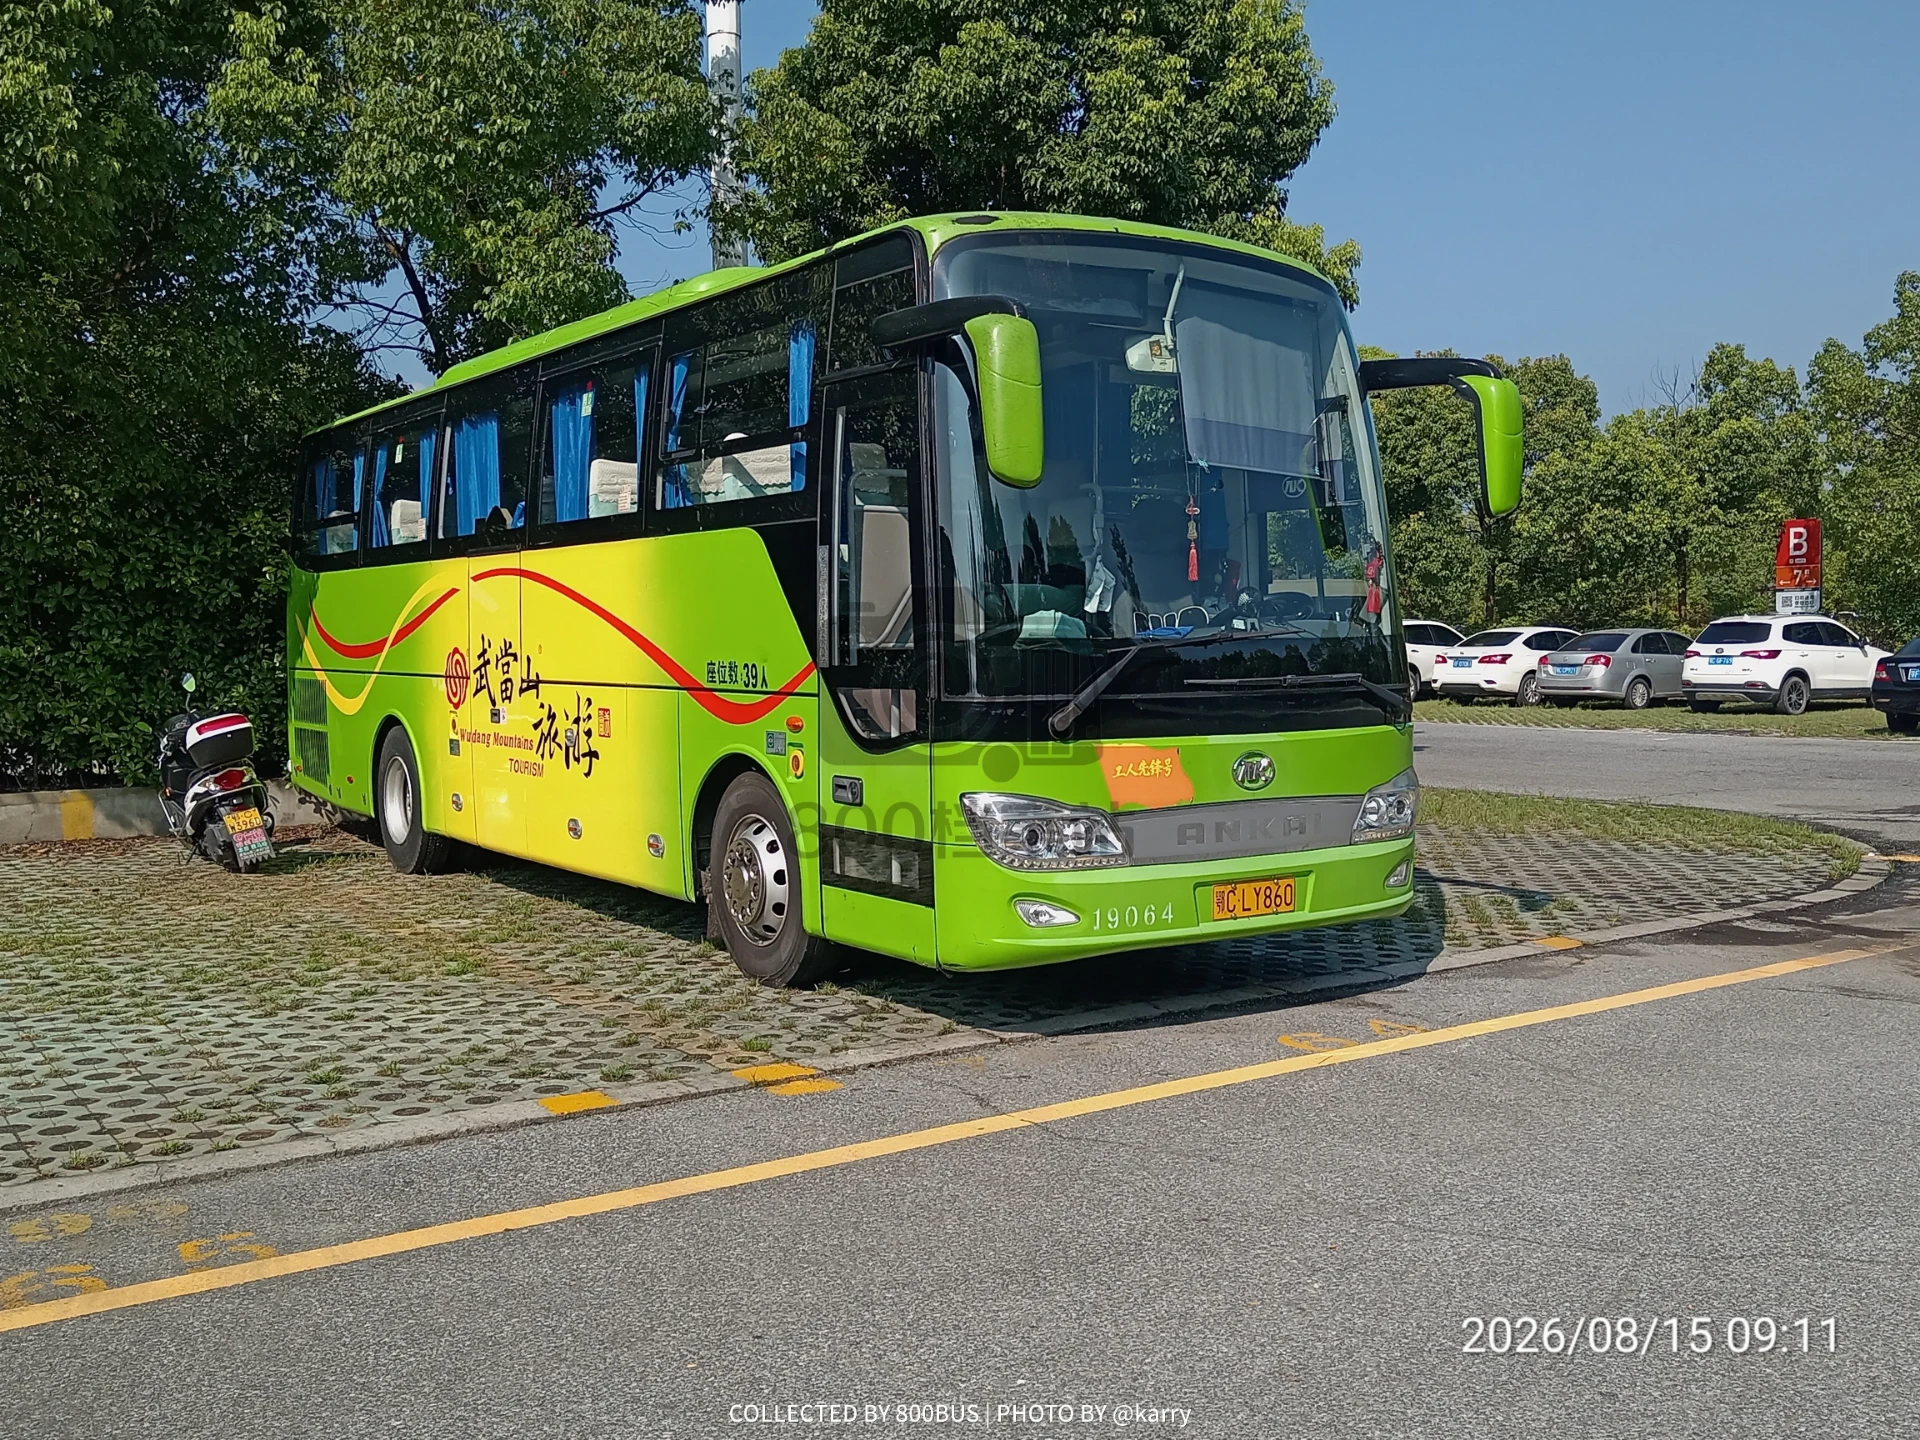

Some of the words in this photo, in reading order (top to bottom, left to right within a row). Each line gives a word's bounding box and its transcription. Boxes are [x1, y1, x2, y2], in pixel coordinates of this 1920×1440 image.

[1789, 527, 1808, 556] B
[472, 633, 541, 708] 武當山
[706, 660, 769, 689] 座位数:39人
[459, 728, 491, 748] Wudang
[492, 732, 535, 751] Mountains
[508, 758, 545, 778] TOURISM
[1112, 757, 1173, 780] 工人先锋号
[1177, 813, 1322, 846] ANKAI
[1092, 902, 1174, 931] 19064
